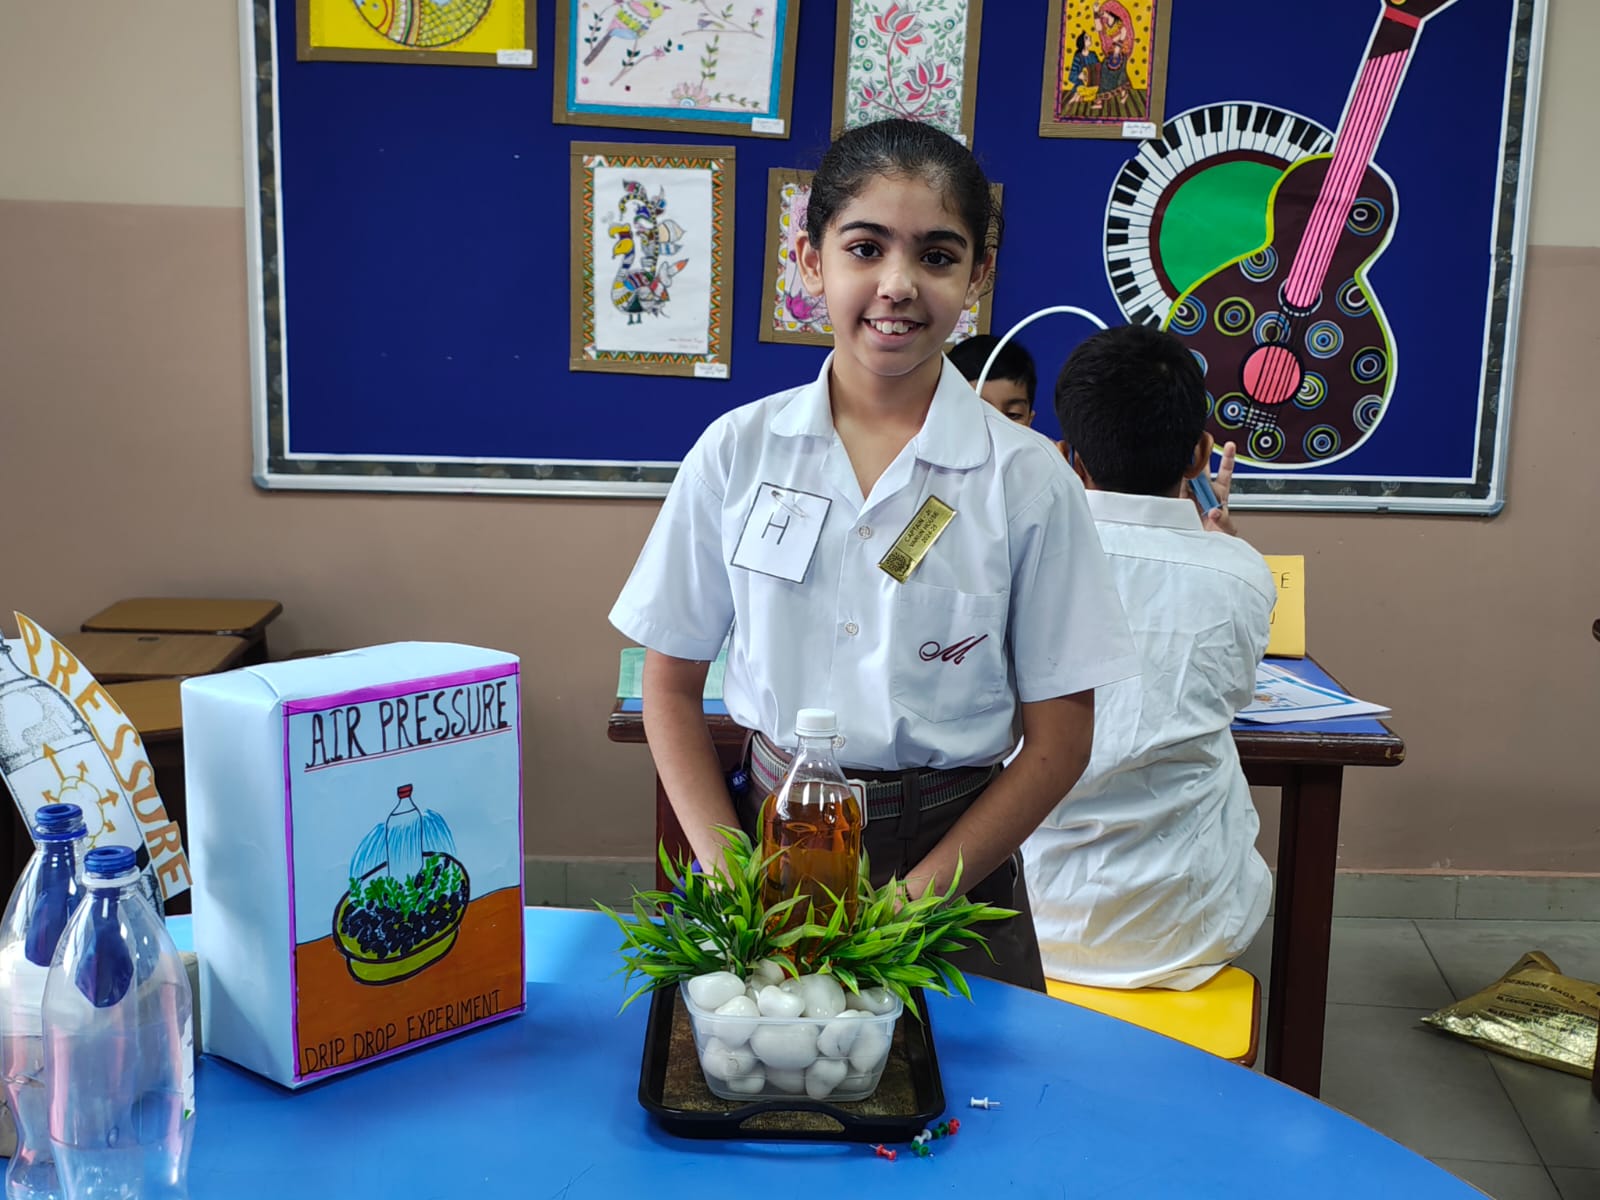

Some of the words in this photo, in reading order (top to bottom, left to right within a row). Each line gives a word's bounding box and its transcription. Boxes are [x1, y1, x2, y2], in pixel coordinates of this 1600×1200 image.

[761, 512, 790, 545] H
[904, 519, 924, 542] CAPTAIN
[923, 511, 940, 530] HOUSE
[305, 706, 367, 768] AIR
[378, 680, 508, 753] PRESSURE
[16, 611, 192, 899] PRESSURE
[1503, 979, 1549, 990] DESIGNER
[304, 1038, 345, 1073] DRIP
[353, 1022, 397, 1060] DROP
[406, 989, 501, 1042] EXPERIMENT
